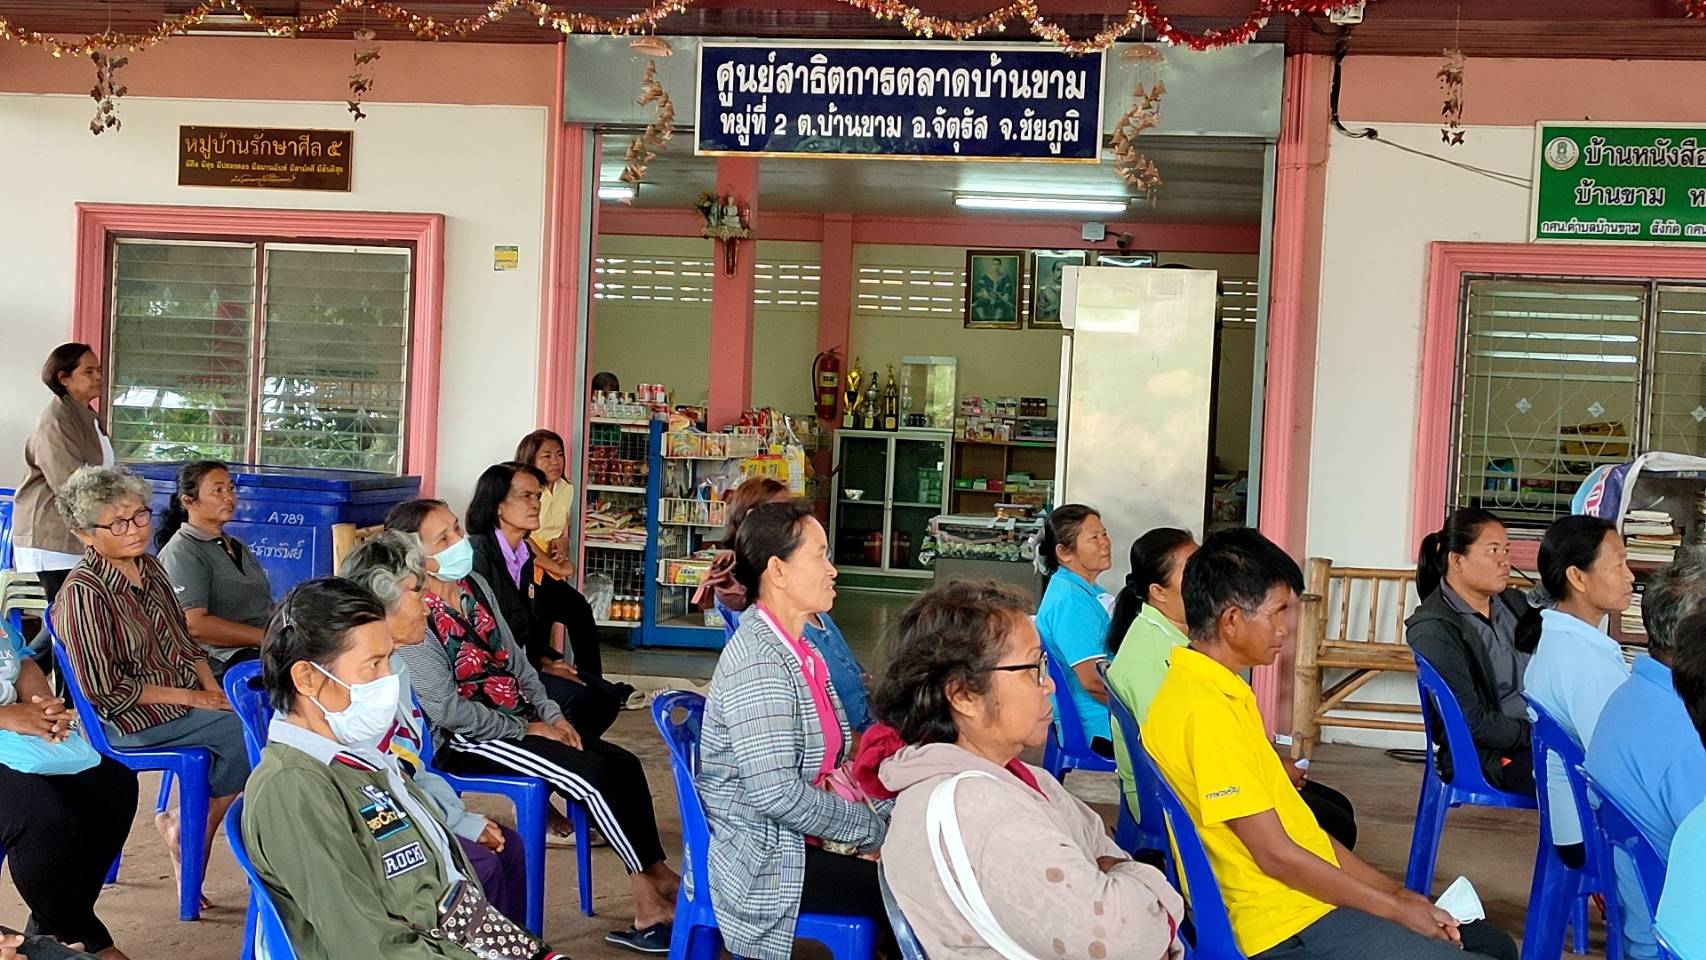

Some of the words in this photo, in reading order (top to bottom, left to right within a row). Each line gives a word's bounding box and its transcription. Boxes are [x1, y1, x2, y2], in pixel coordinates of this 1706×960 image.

[716, 51, 1087, 106] ศูนย์สาธิตการตลาดบ้านขาม
[720, 97, 766, 146] หมู่ที่
[773, 116, 787, 136] 2
[797, 103, 902, 138] ต.บ้านขาม
[911, 105, 988, 152] อ.จัตุรัส
[999, 109, 1080, 154] จ.ชัยภูมิ
[184, 132, 322, 159] หมู่บ้านรักษาศีล
[1575, 178, 1665, 206] บ้านขาม
[1541, 217, 1640, 234] กศน.ตำบลบ้านขาม
[1650, 220, 1681, 235] สังกัด
[384, 846, 423, 873] ROCK
